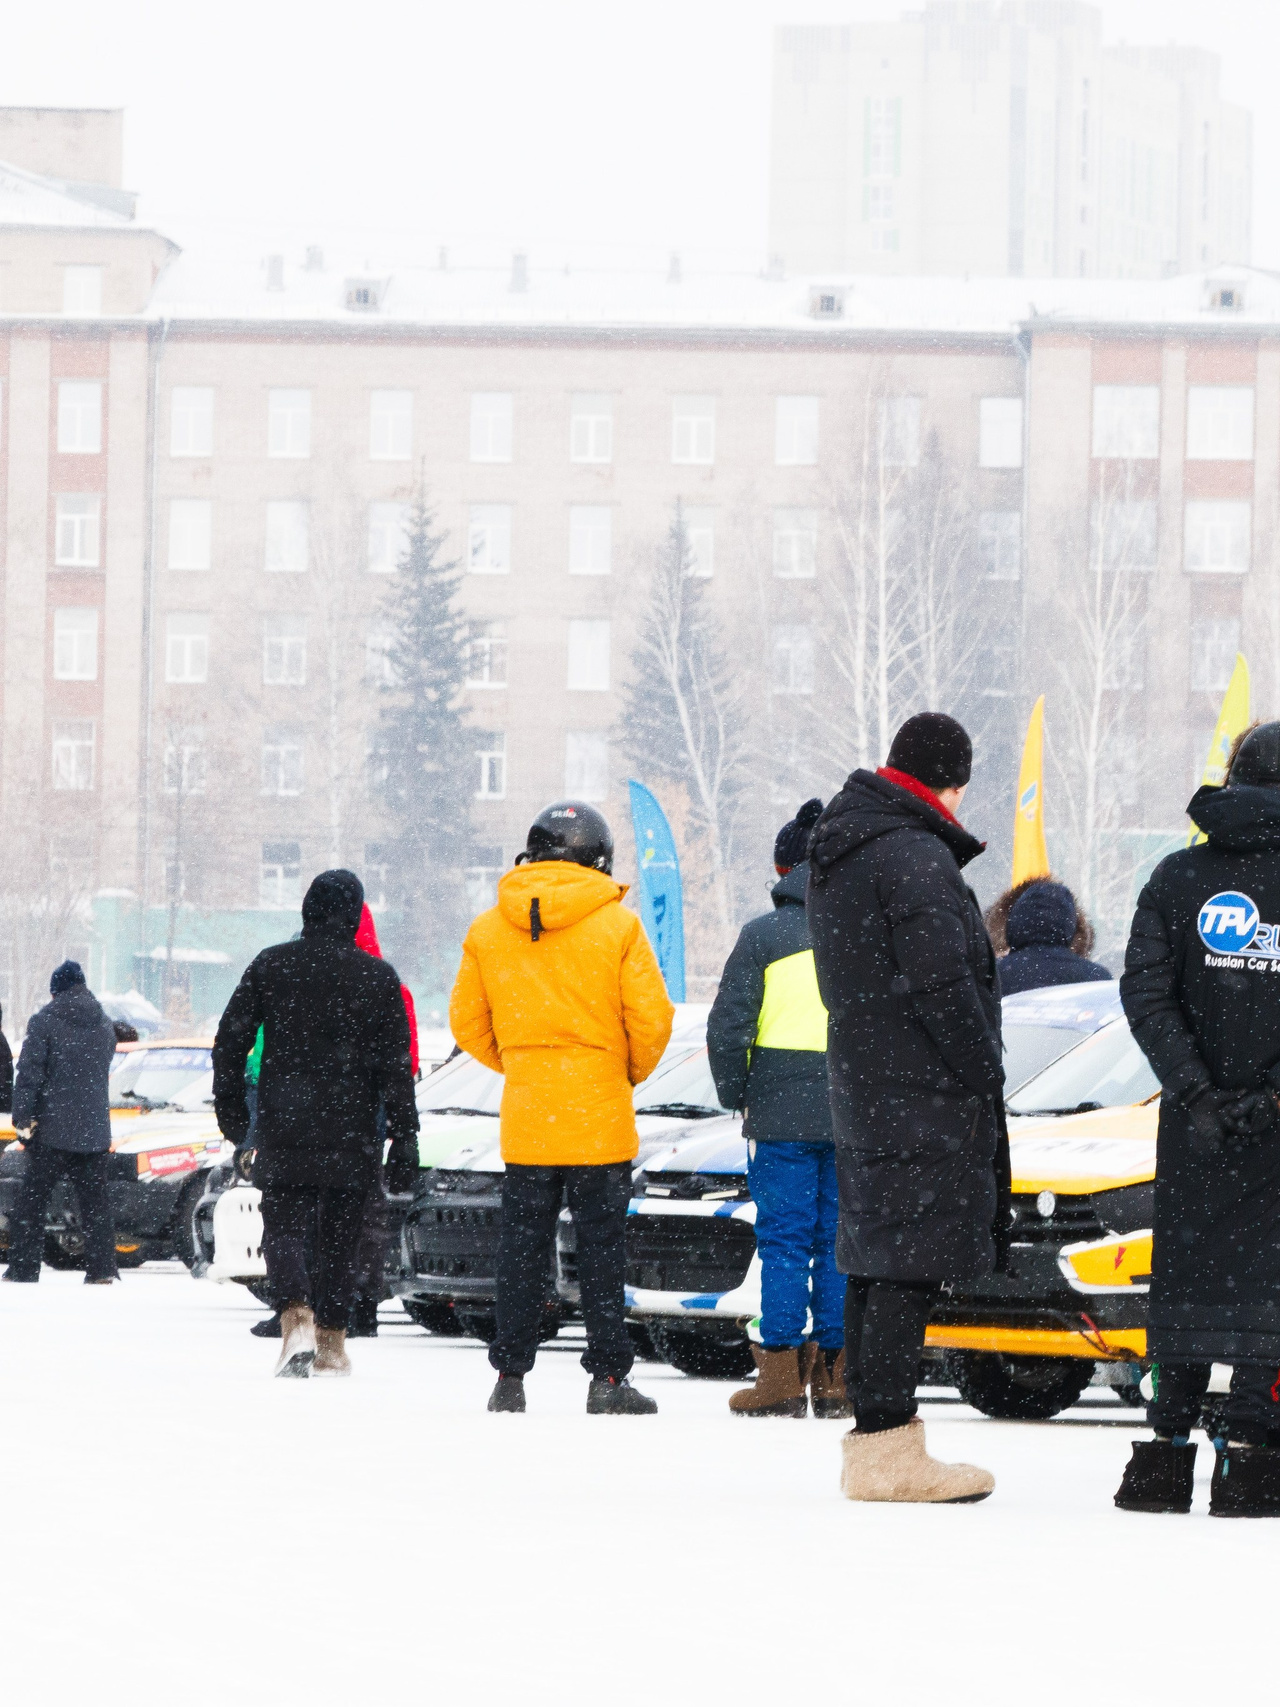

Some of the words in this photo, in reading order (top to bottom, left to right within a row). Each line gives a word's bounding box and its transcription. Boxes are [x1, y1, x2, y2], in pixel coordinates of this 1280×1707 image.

[1201, 905, 1258, 936] TPV
[1205, 954, 1244, 970] Russian
[1247, 957, 1268, 971] Car
